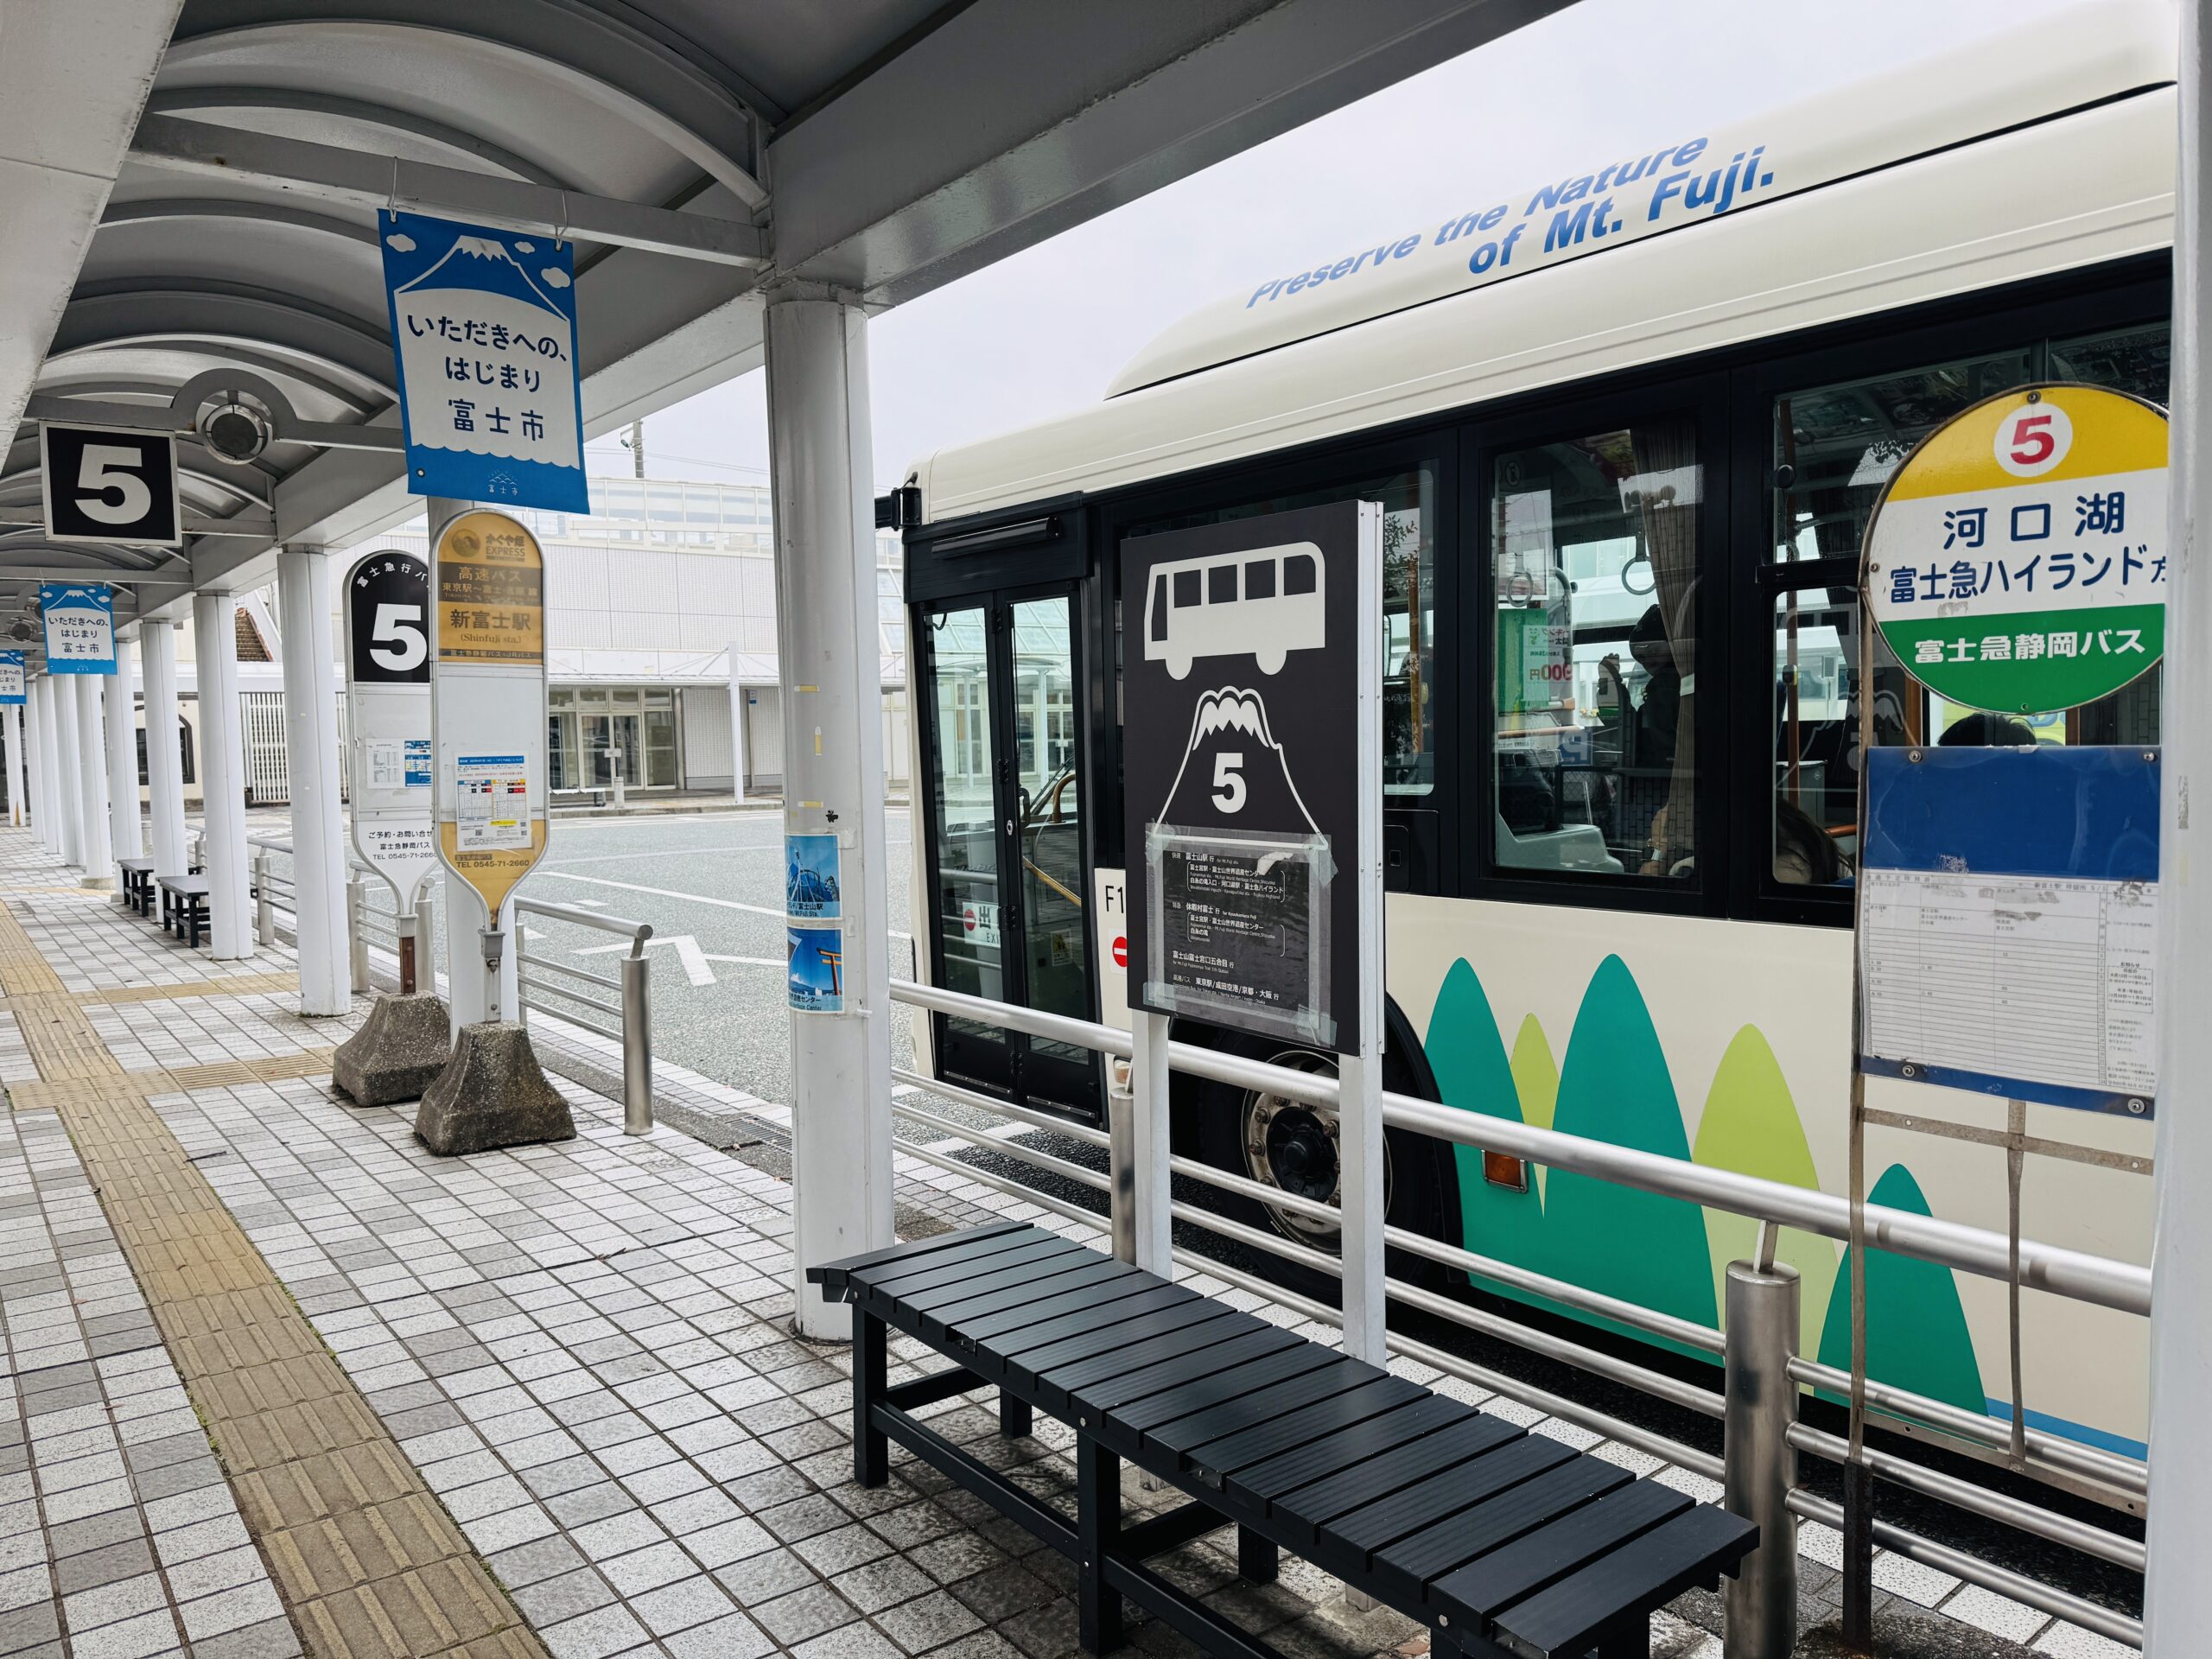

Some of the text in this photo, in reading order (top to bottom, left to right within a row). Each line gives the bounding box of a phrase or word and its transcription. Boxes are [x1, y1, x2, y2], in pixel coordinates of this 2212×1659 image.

[1246, 137, 1708, 308] Preserve the Nature
[1468, 145, 1775, 275] of Mt. Fuji.
[407, 315, 567, 361] いただきへの、
[445, 356, 540, 392] はじまり
[448, 398, 543, 442] 富士市
[2010, 415, 2055, 465] 5
[75, 443, 151, 524] 5
[1943, 492, 2125, 550] 河口湖
[486, 546, 525, 557] EXPRESS
[357, 563, 429, 588] 富士急行バ
[458, 567, 522, 582] 高速バス
[48, 616, 109, 627] いただきへの、
[60, 628, 98, 639] はじまり
[369, 603, 428, 671] 5
[449, 609, 531, 631] 新富士駅
[61, 642, 99, 654] 富士市
[1915, 629, 2145, 664] 富士急静岡バス
[1211, 752, 1247, 814] 5
[379, 842, 430, 850] 富士急静岡バス
[1185, 852, 1208, 862] 富士山駅
